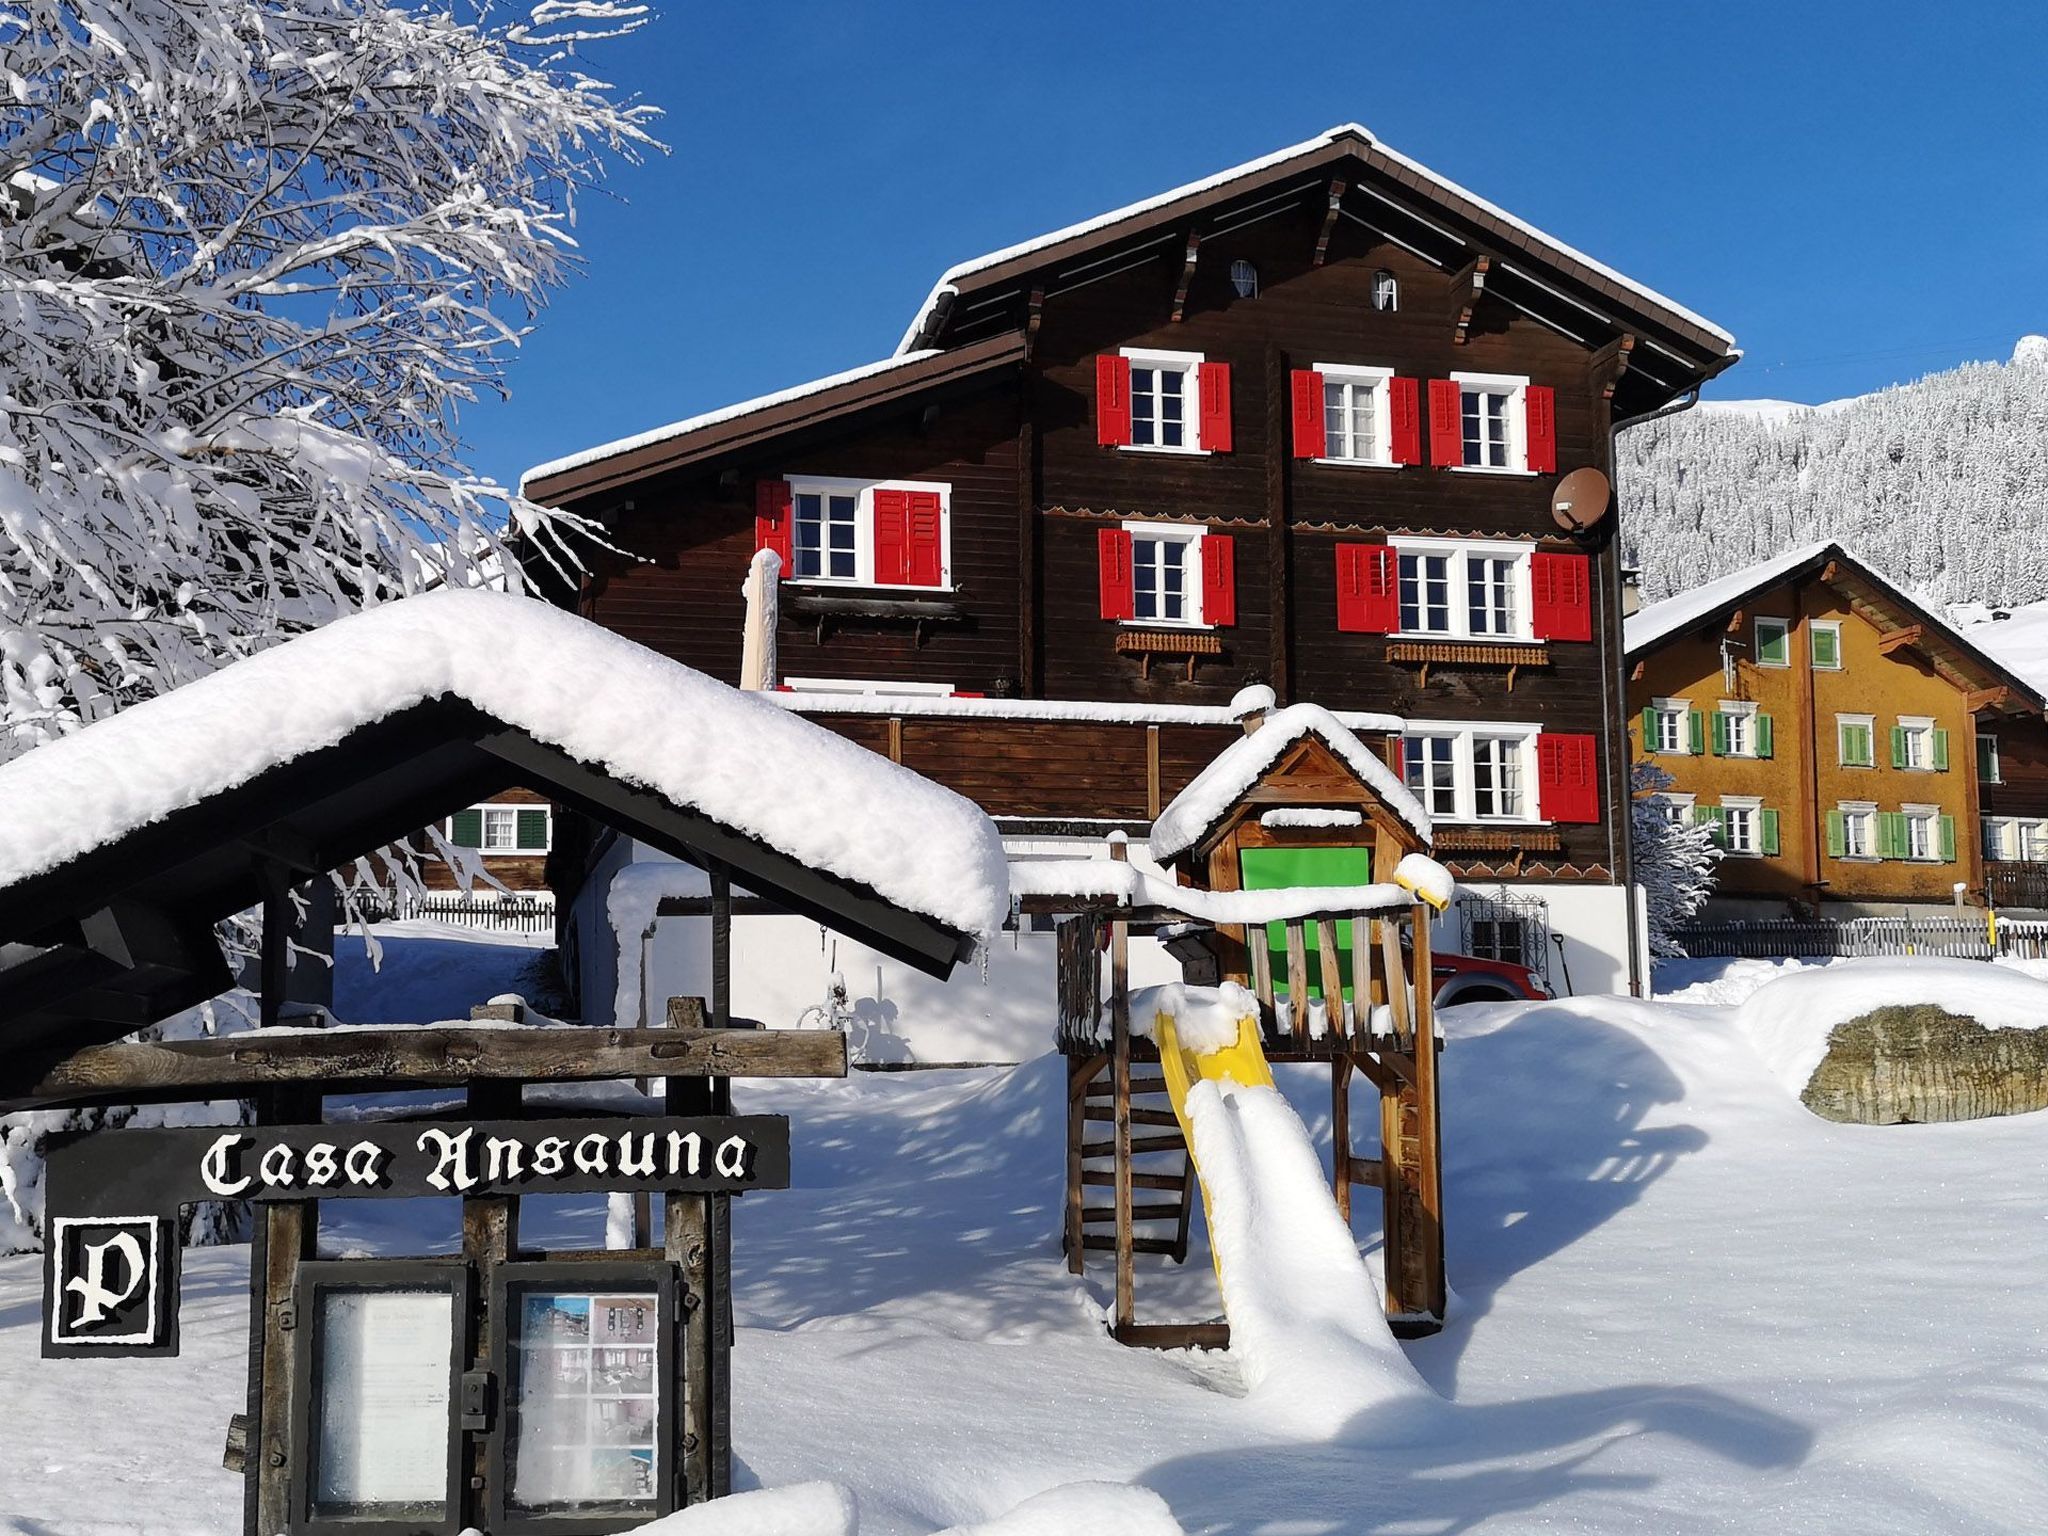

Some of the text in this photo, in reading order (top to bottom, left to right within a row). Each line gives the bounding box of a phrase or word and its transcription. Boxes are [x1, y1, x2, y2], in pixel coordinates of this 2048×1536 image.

[200, 1127, 748, 1196] Casa Ansauna
[66, 1230, 148, 1329] P
